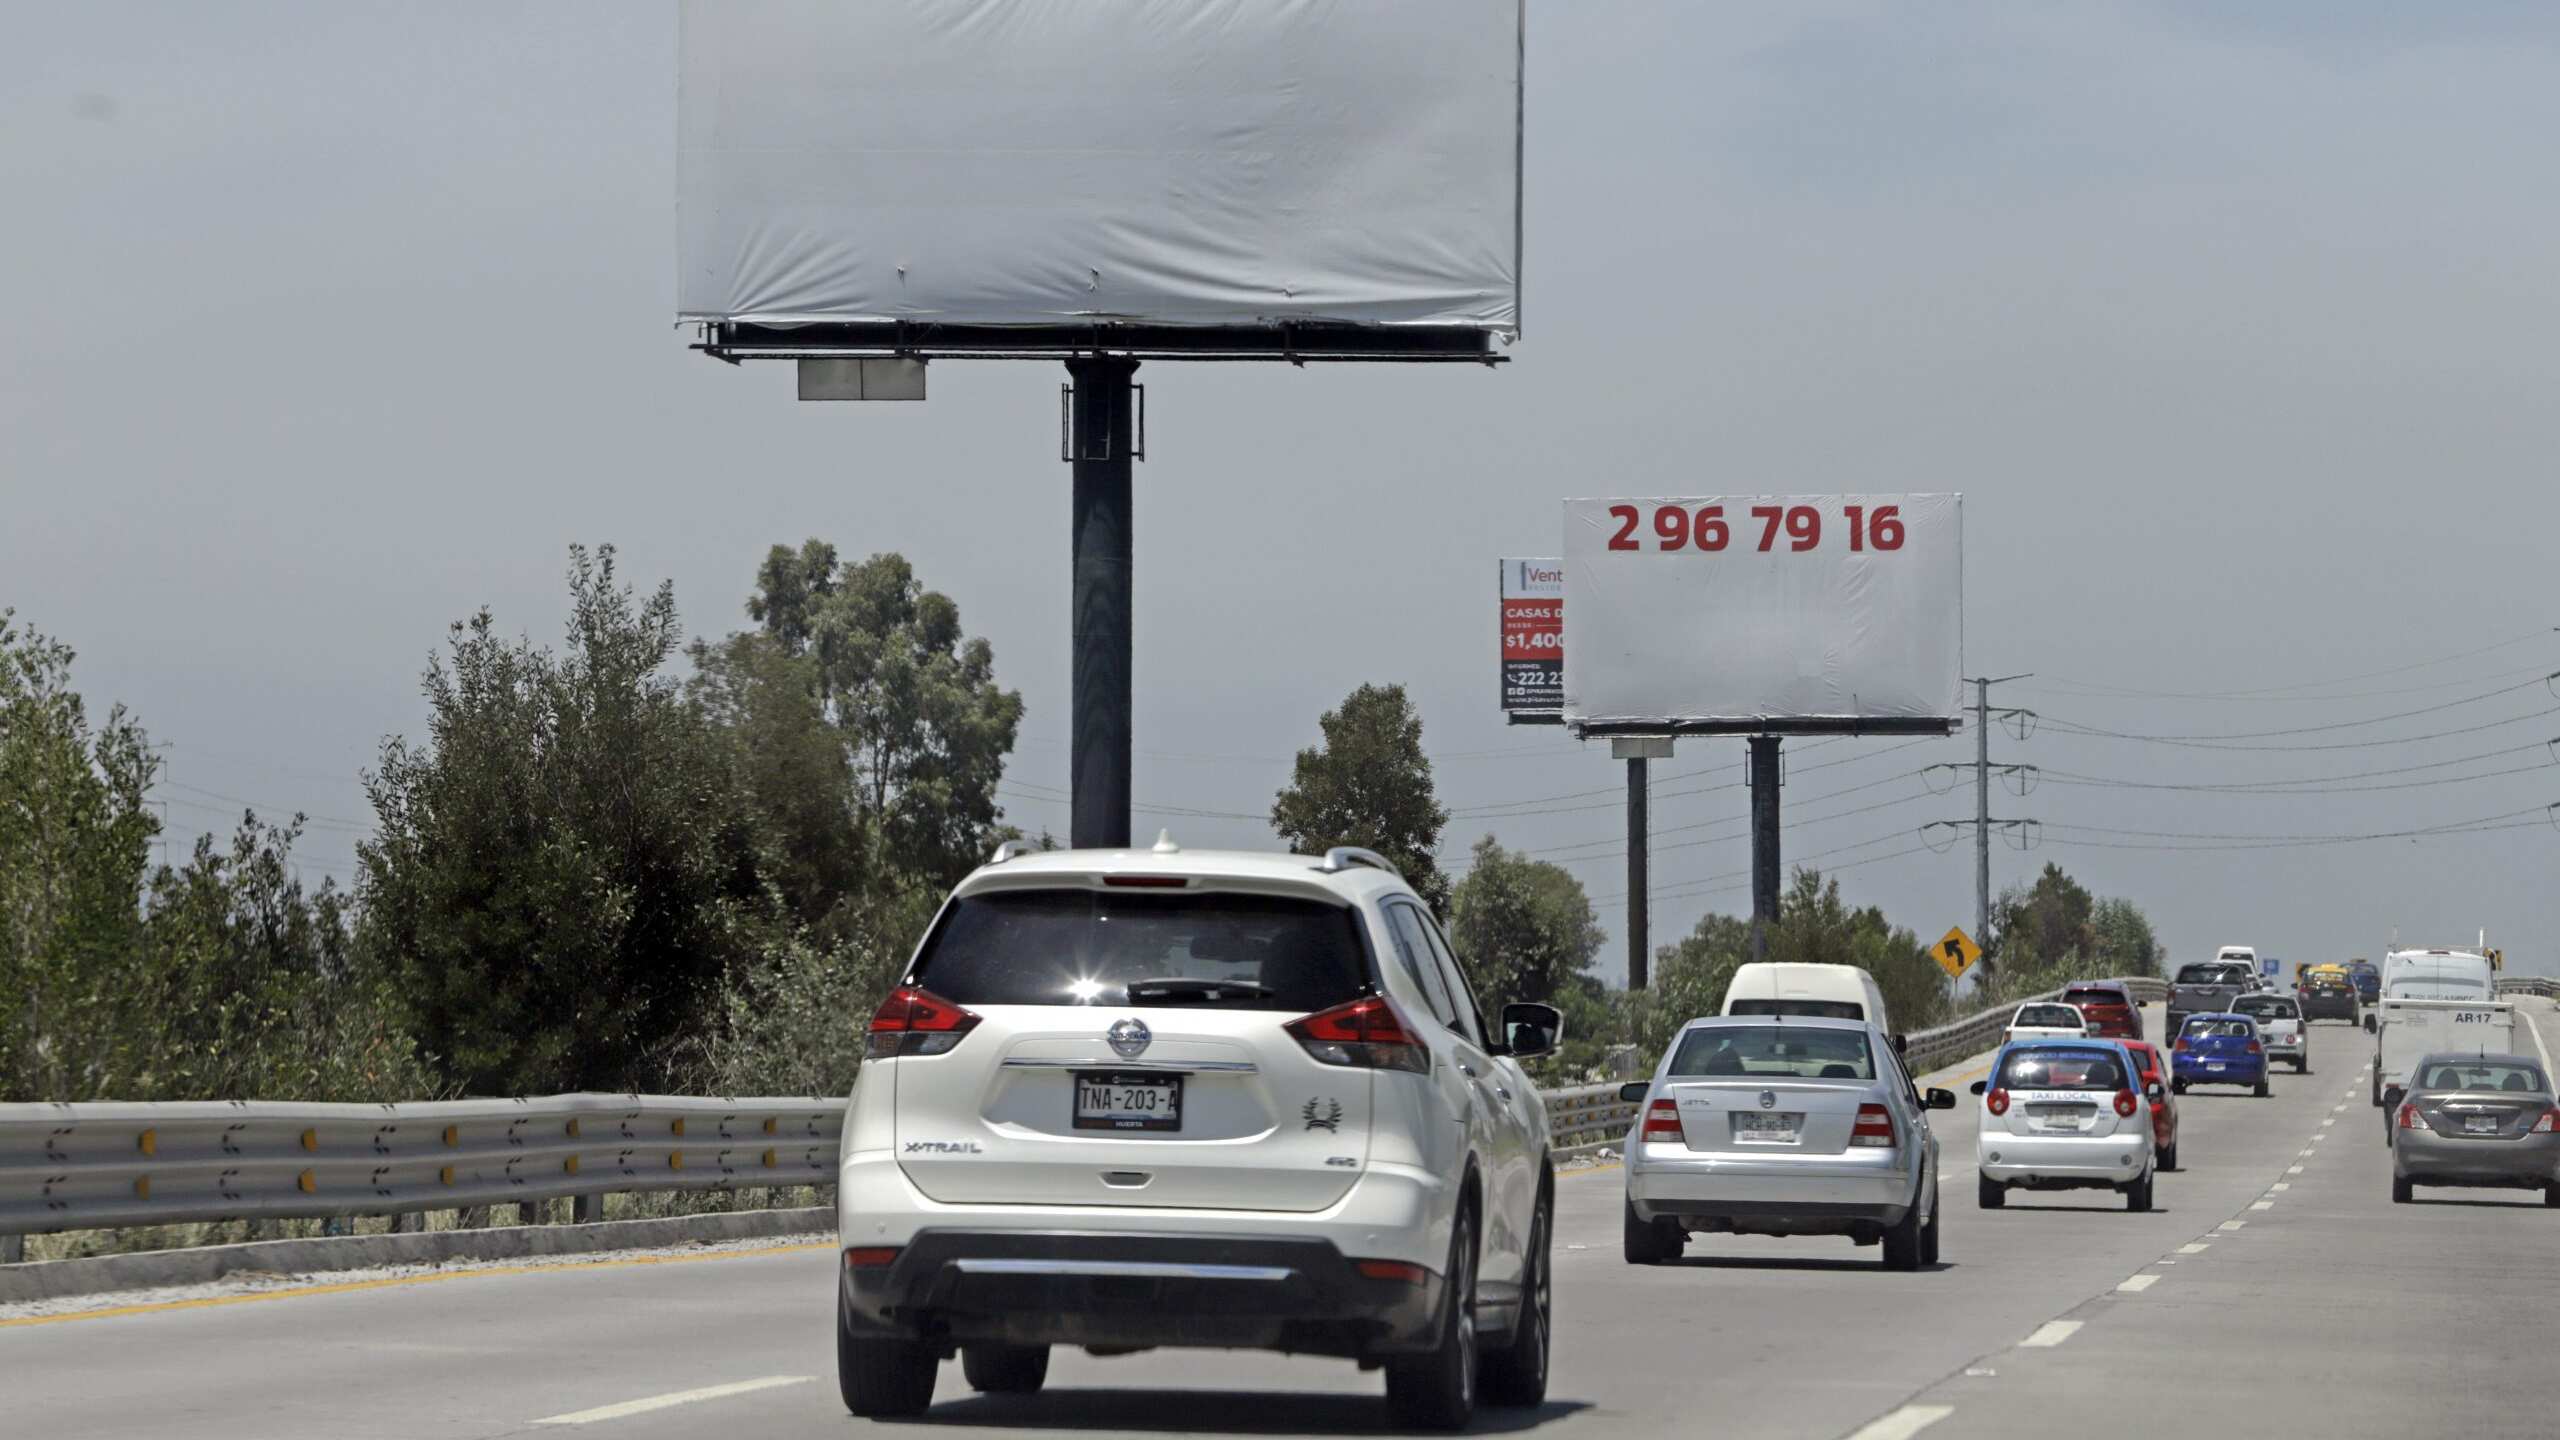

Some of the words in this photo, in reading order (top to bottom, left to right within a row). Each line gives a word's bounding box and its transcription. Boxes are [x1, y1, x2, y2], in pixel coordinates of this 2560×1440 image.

[1751, 506, 1821, 551] 79
[1844, 505, 1905, 551] 16
[1527, 567, 1563, 582] Vent
[1506, 608, 1551, 618] CASAS
[1518, 671, 1545, 685] 222
[2032, 1091, 2054, 1100] TAXI
[2057, 1091, 2094, 1100] LOCAL
[905, 1142, 982, 1153] X-TRAIL
